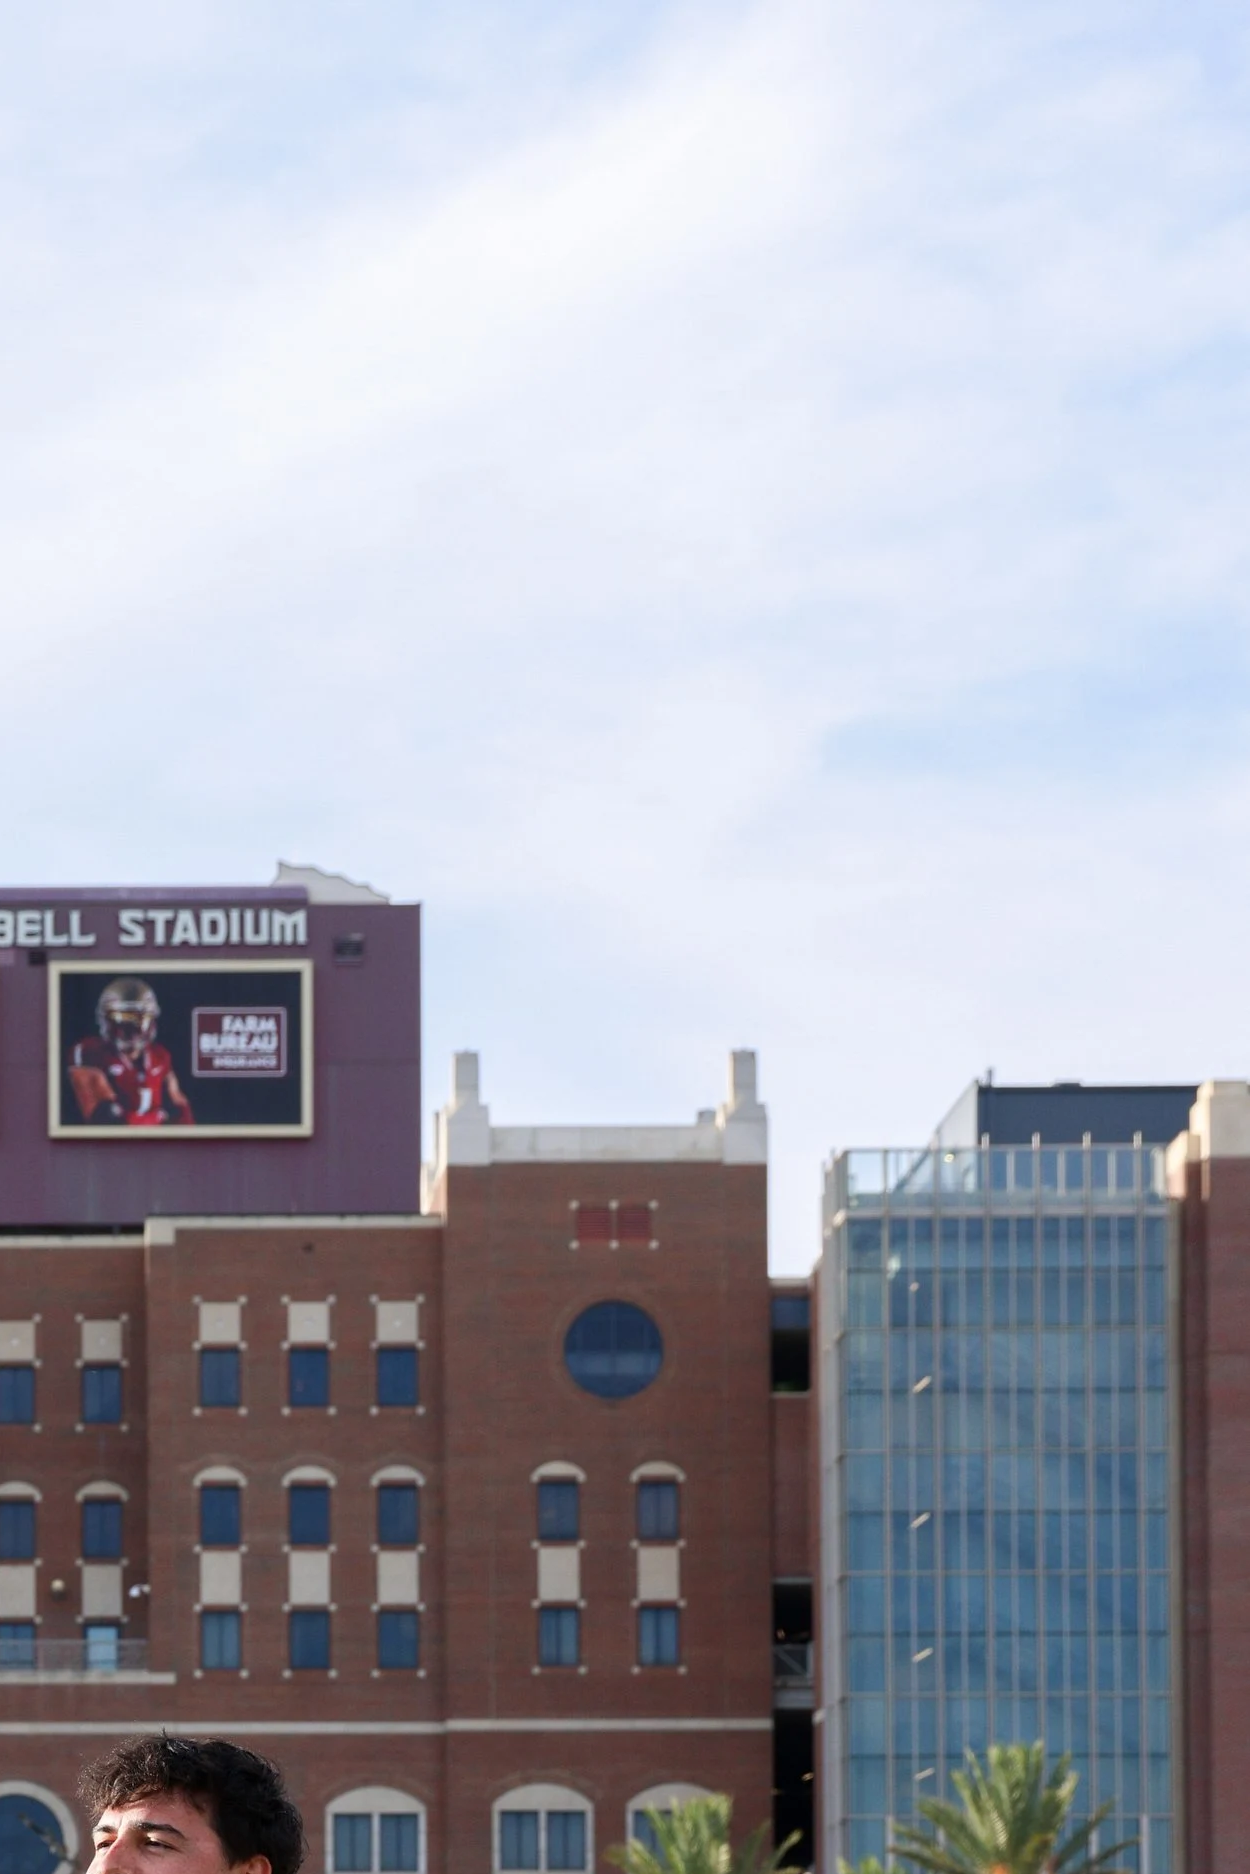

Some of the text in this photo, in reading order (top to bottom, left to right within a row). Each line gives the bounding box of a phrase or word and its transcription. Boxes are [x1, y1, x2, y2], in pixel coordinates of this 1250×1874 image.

[118, 909, 308, 946] STADIUM
[222, 1014, 276, 1031] FARM
[199, 1032, 278, 1053] BUREAU
